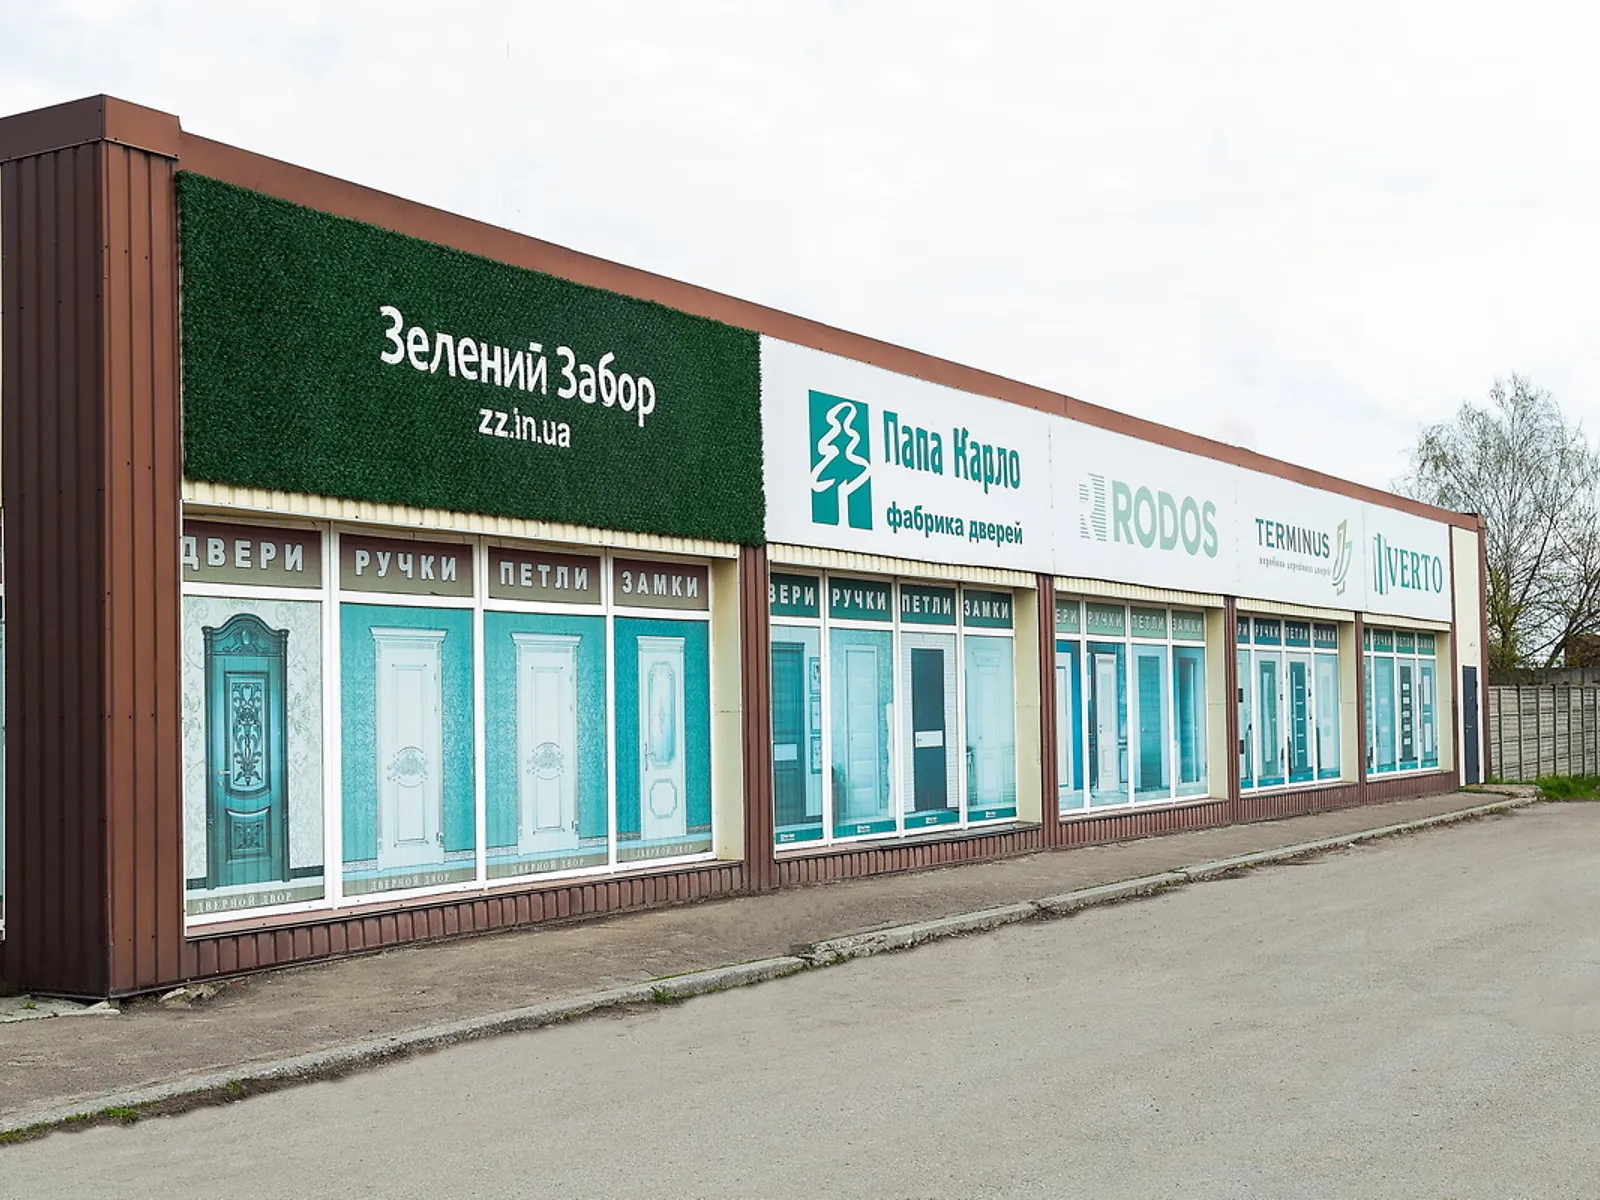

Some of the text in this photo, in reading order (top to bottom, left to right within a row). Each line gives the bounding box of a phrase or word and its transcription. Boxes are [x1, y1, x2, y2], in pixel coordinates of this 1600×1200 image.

[379, 305, 656, 427] Зелений Забор
[478, 407, 571, 448] zz.in.ua
[883, 410, 1021, 494] Папа Карло
[886, 501, 1023, 548] фабрика дверей
[1111, 479, 1218, 558] RODOS
[182, 535, 304, 572] ДВЕРИ
[1255, 517, 1330, 559] TERMINUS
[354, 549, 457, 582] РУЧКИ
[500, 561, 589, 591] ПЕТЛИ
[1386, 546, 1443, 594] VERTO
[621, 570, 699, 599] ЗАМКИ
[832, 587, 887, 611] РУЧКИ
[901, 594, 951, 615] ПЕТЛИ
[964, 599, 1010, 619] ЗАМКИ
[196, 892, 292, 914] ДВЕРНОЙ ДВОР
